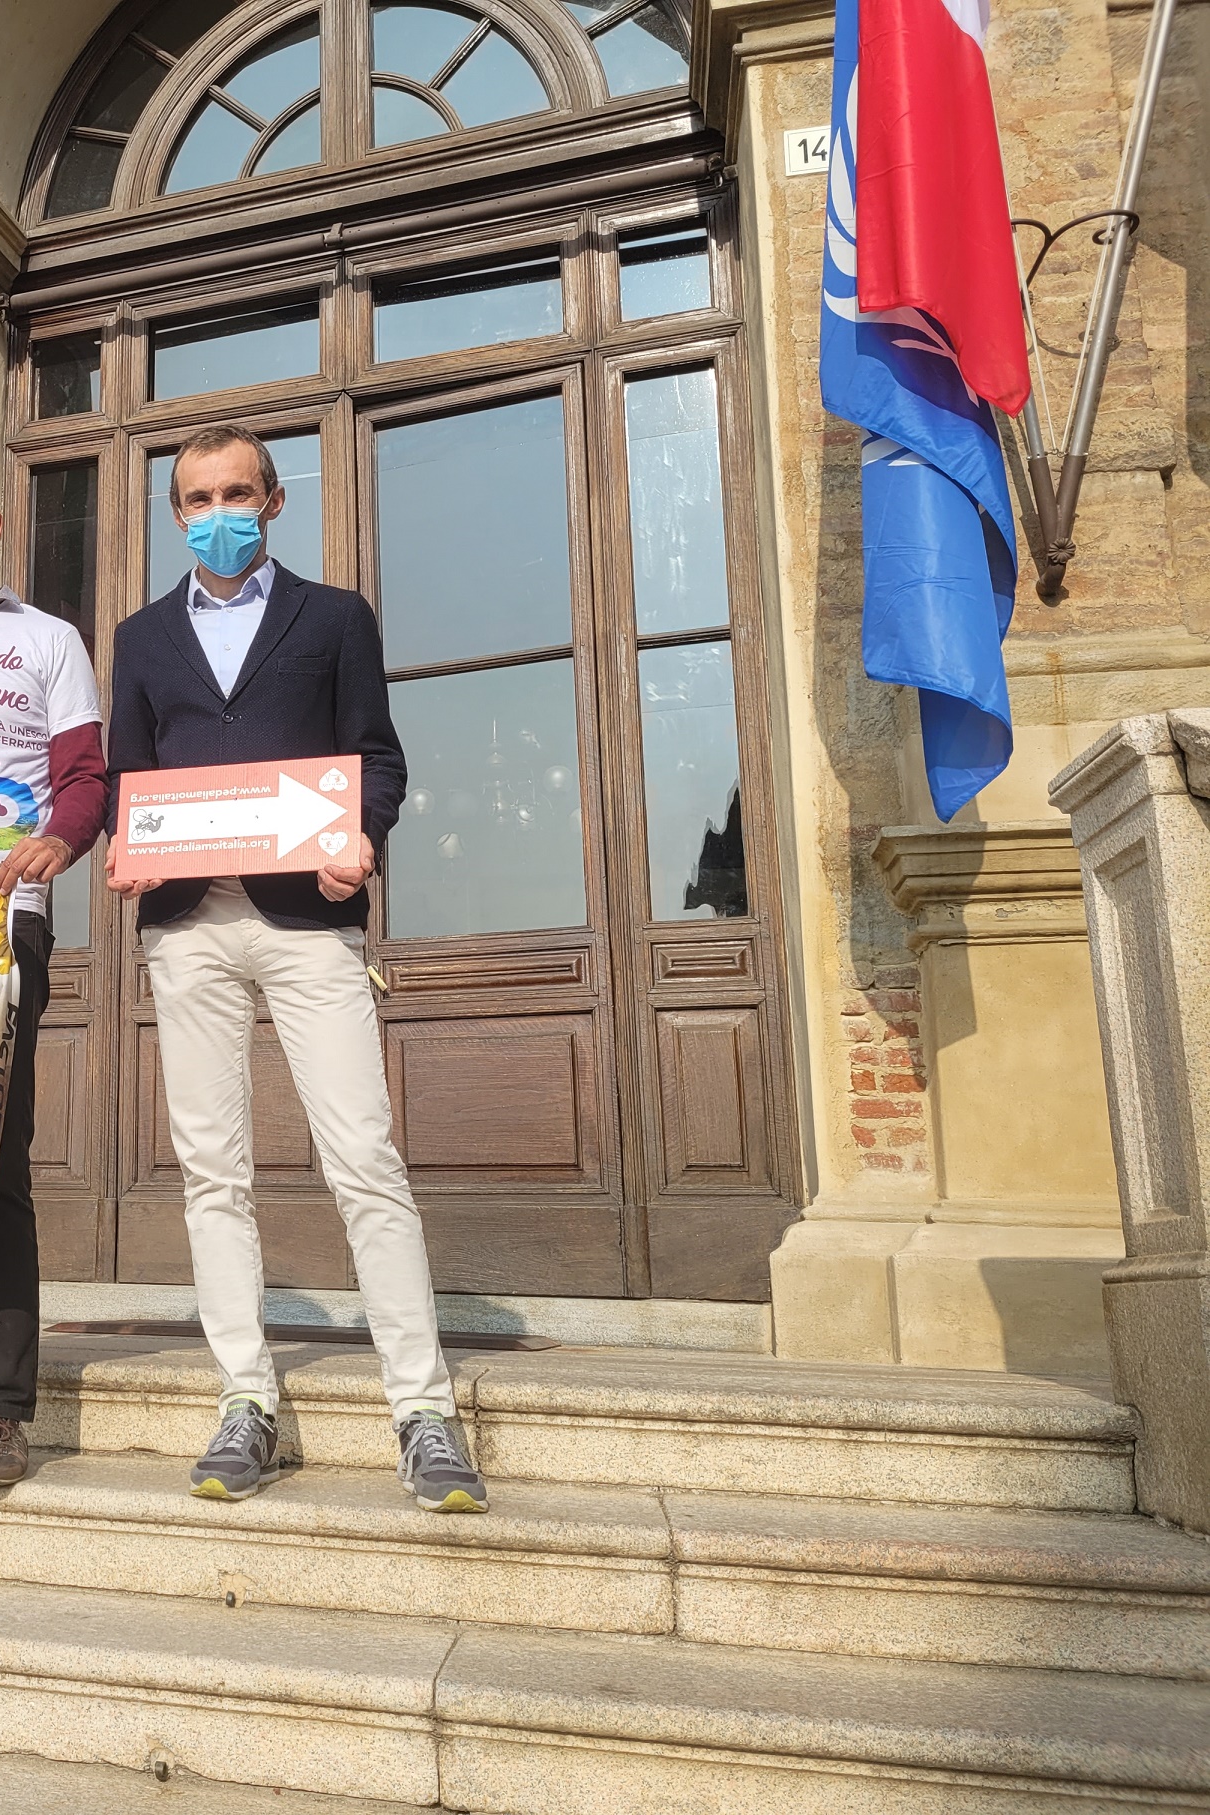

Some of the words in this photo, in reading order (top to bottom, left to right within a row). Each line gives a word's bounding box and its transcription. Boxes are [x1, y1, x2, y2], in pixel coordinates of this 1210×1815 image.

[797, 135, 828, 164] 14
[9, 724, 48, 741] UNESCO
[129, 785, 272, 804] www.pedaliamoitalia.org
[126, 838, 271, 856] www.pedaliamoitalia.org
